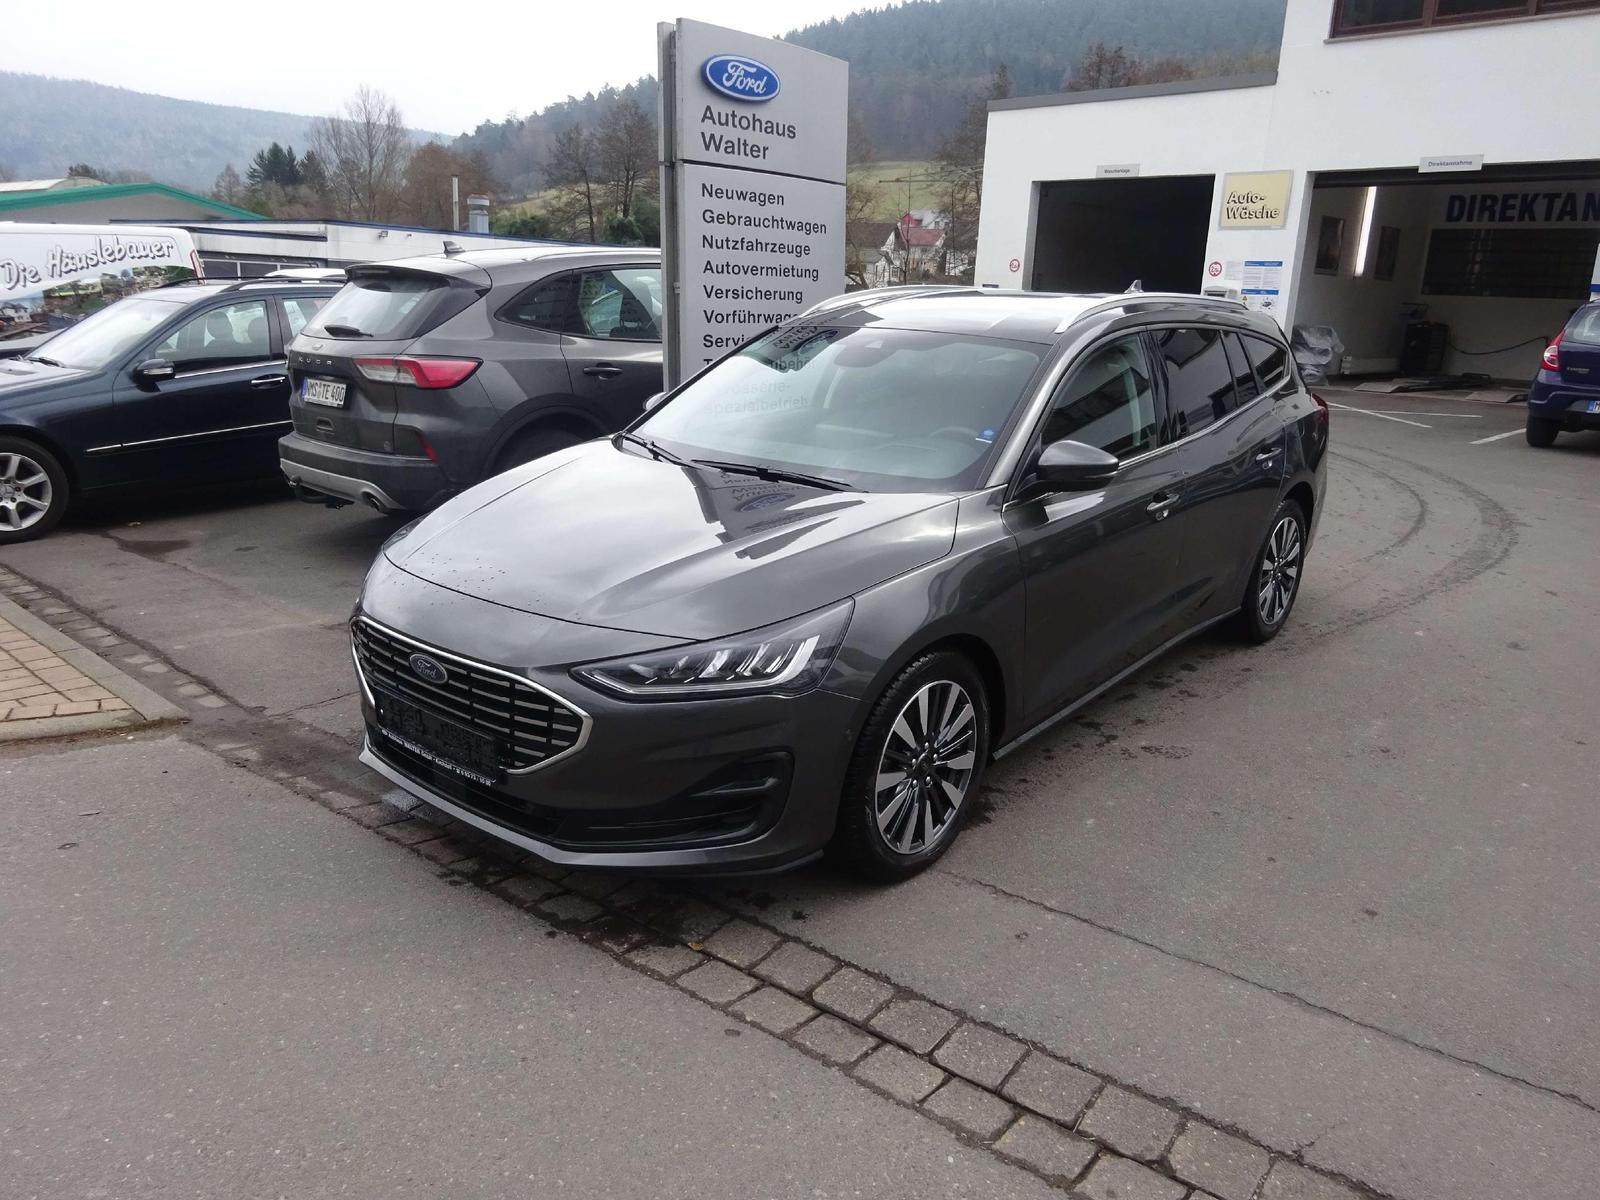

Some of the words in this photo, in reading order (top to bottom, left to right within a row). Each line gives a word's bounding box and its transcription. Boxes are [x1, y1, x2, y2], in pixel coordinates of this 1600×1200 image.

[722, 61, 766, 94] Ford
[701, 105, 797, 139] Autohaus
[701, 132, 769, 159] Walter
[702, 183, 785, 206] Neuwagen
[1226, 191, 1265, 204] Auto-
[702, 209, 827, 235] Gebrauchtwagen
[1226, 205, 1280, 220] Wäsche
[702, 234, 811, 258] Nutzfahrzeuge
[0, 259, 42, 290] Die
[46, 234, 174, 279] Häuslebauer
[703, 260, 819, 282] Autovermietung
[703, 284, 803, 304] Versicherung
[331, 385, 345, 402] 400
[416, 659, 438, 679] Ford
